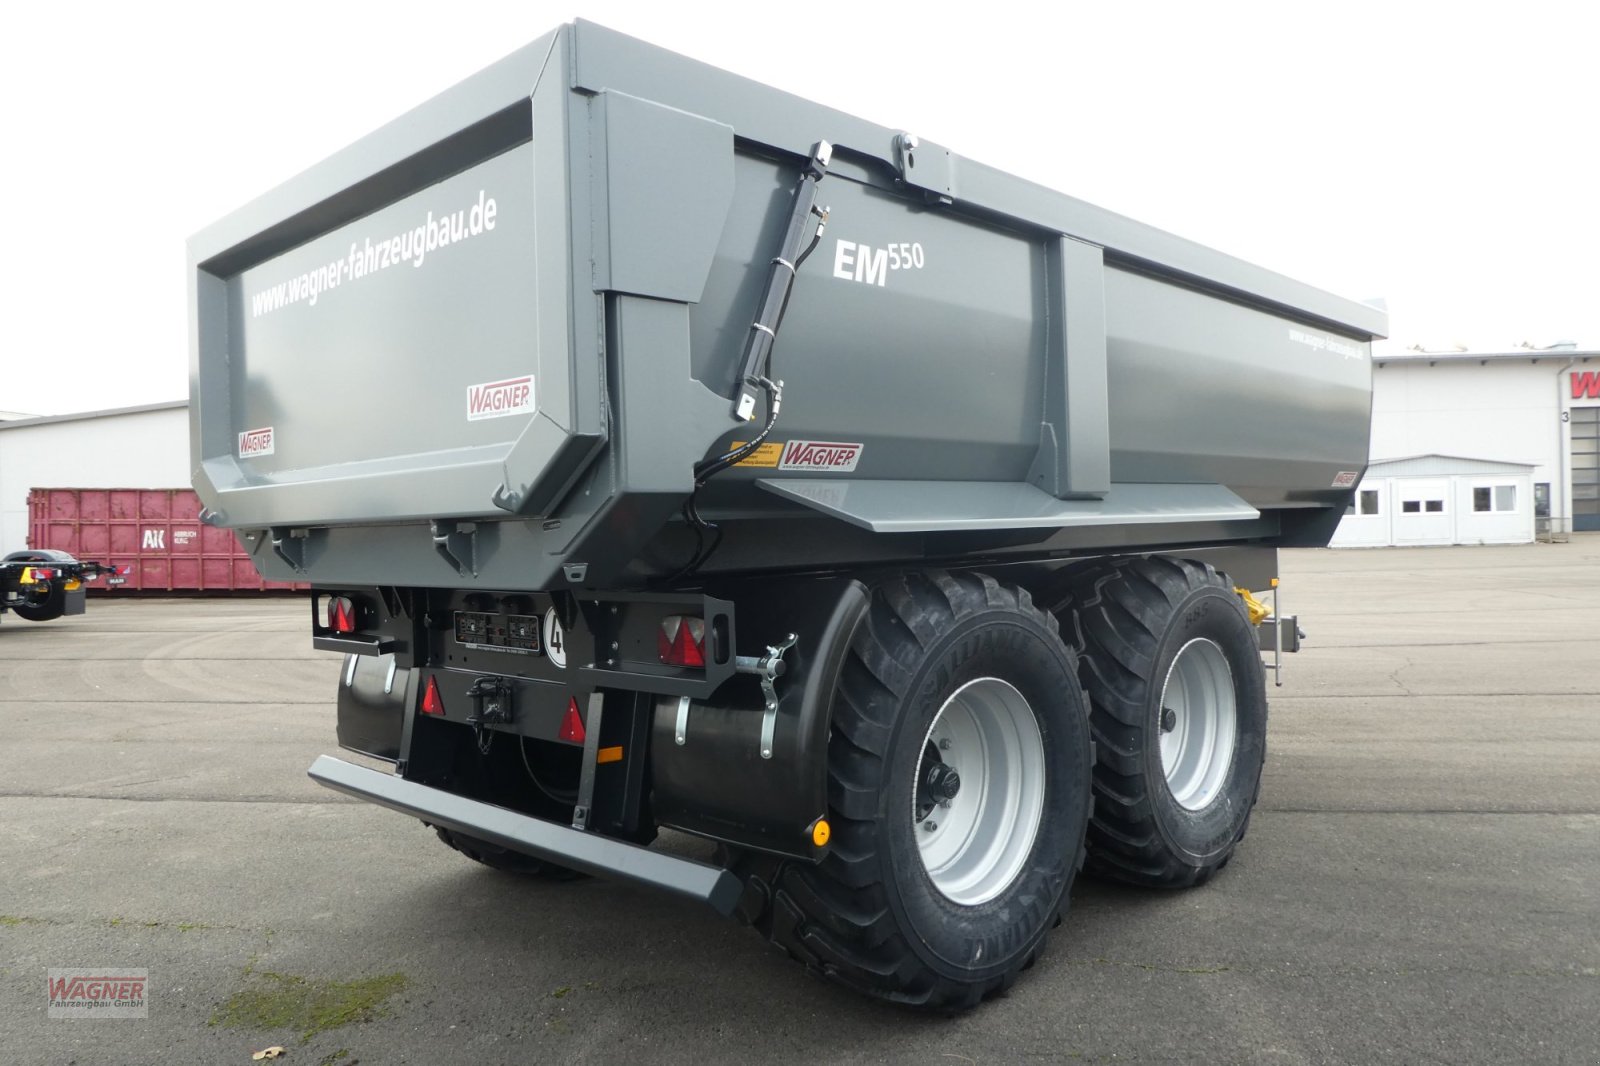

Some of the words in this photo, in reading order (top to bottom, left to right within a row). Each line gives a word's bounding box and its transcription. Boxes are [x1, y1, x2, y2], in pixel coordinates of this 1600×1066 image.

[252, 189, 497, 318] www.wagner-fahrzeugbau.de
[469, 378, 531, 414] WAGNER
[1561, 411, 1569, 423] 3
[784, 442, 859, 466] WAGNER
[142, 529, 165, 549] AK
[550, 614, 562, 654] 4
